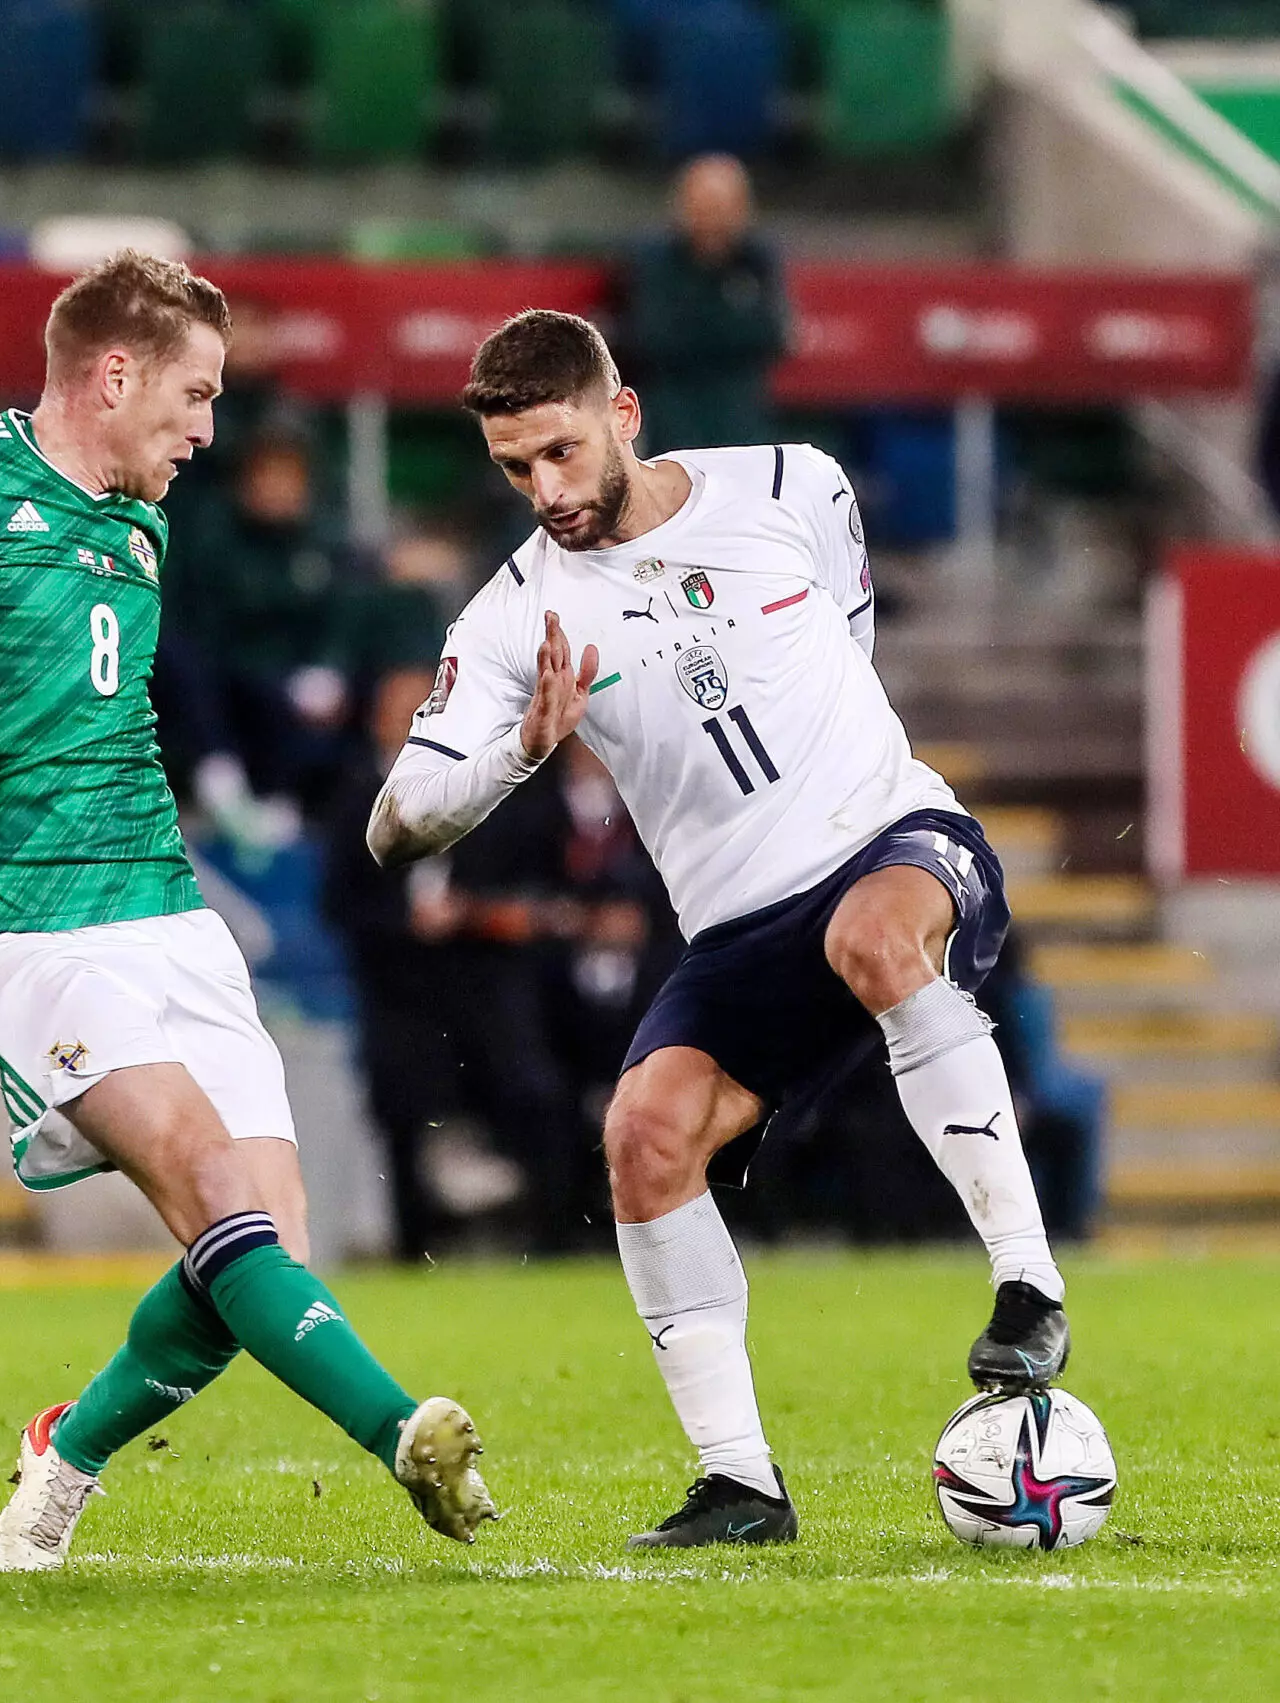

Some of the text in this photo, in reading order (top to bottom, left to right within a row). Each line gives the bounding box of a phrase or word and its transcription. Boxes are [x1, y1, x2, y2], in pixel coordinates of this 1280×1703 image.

[7, 521, 50, 532] adidas
[682, 572, 706, 590] ITALIA
[90, 603, 120, 696] 8
[641, 618, 736, 667] ITALIA
[683, 655, 712, 671] EUROPEAN
[684, 660, 714, 676] CHAMPIONS
[706, 694, 721, 704] 2020
[701, 704, 781, 796] 11
[931, 830, 975, 879] 11
[294, 1314, 345, 1342] adidas
